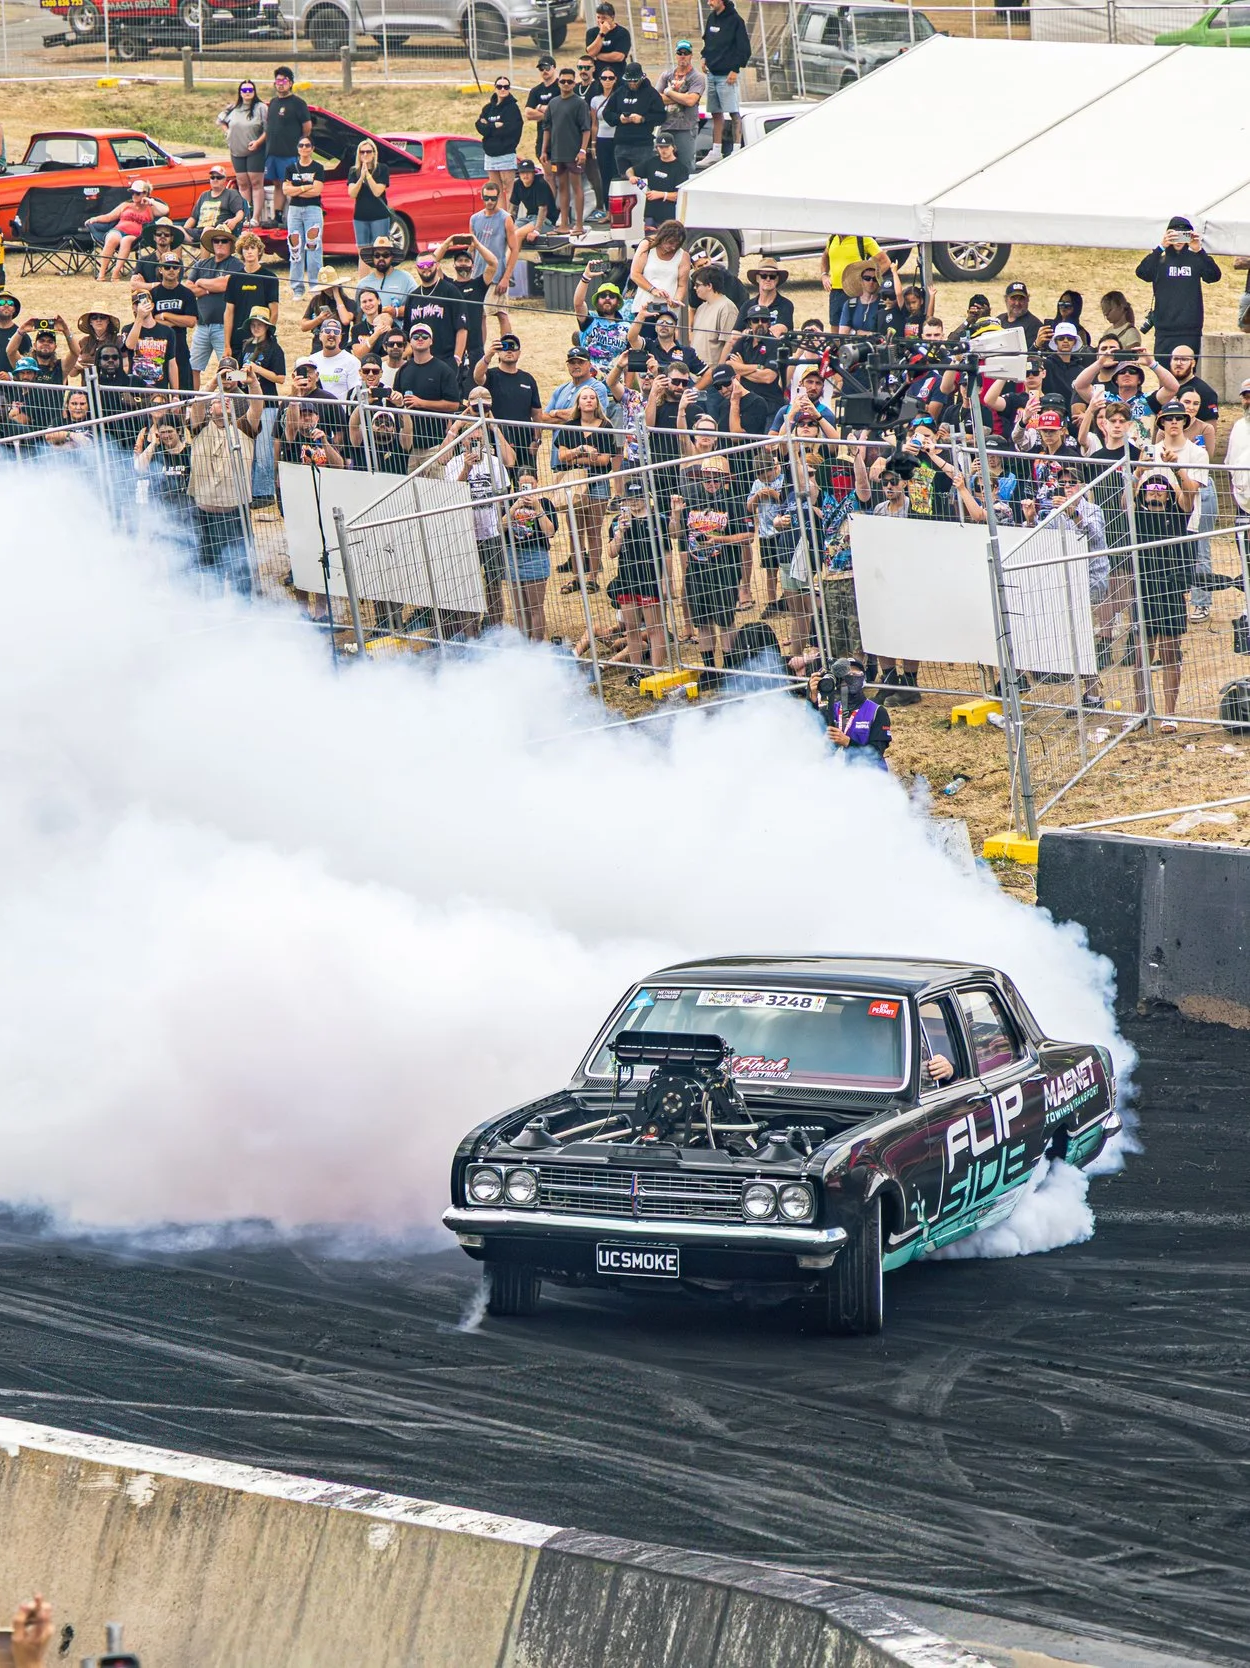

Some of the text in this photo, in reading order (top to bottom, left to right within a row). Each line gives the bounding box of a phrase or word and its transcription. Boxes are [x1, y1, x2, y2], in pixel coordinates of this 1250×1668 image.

[765, 994, 813, 1009] 3248
[748, 1070, 792, 1080] DETAILING
[1043, 1055, 1096, 1112] MAGNET
[1072, 1083, 1099, 1110] TRANSPORT
[946, 1083, 1024, 1174] FLIP
[942, 1138, 1029, 1216] SIDE
[598, 1250, 677, 1271] UCSMOKE
